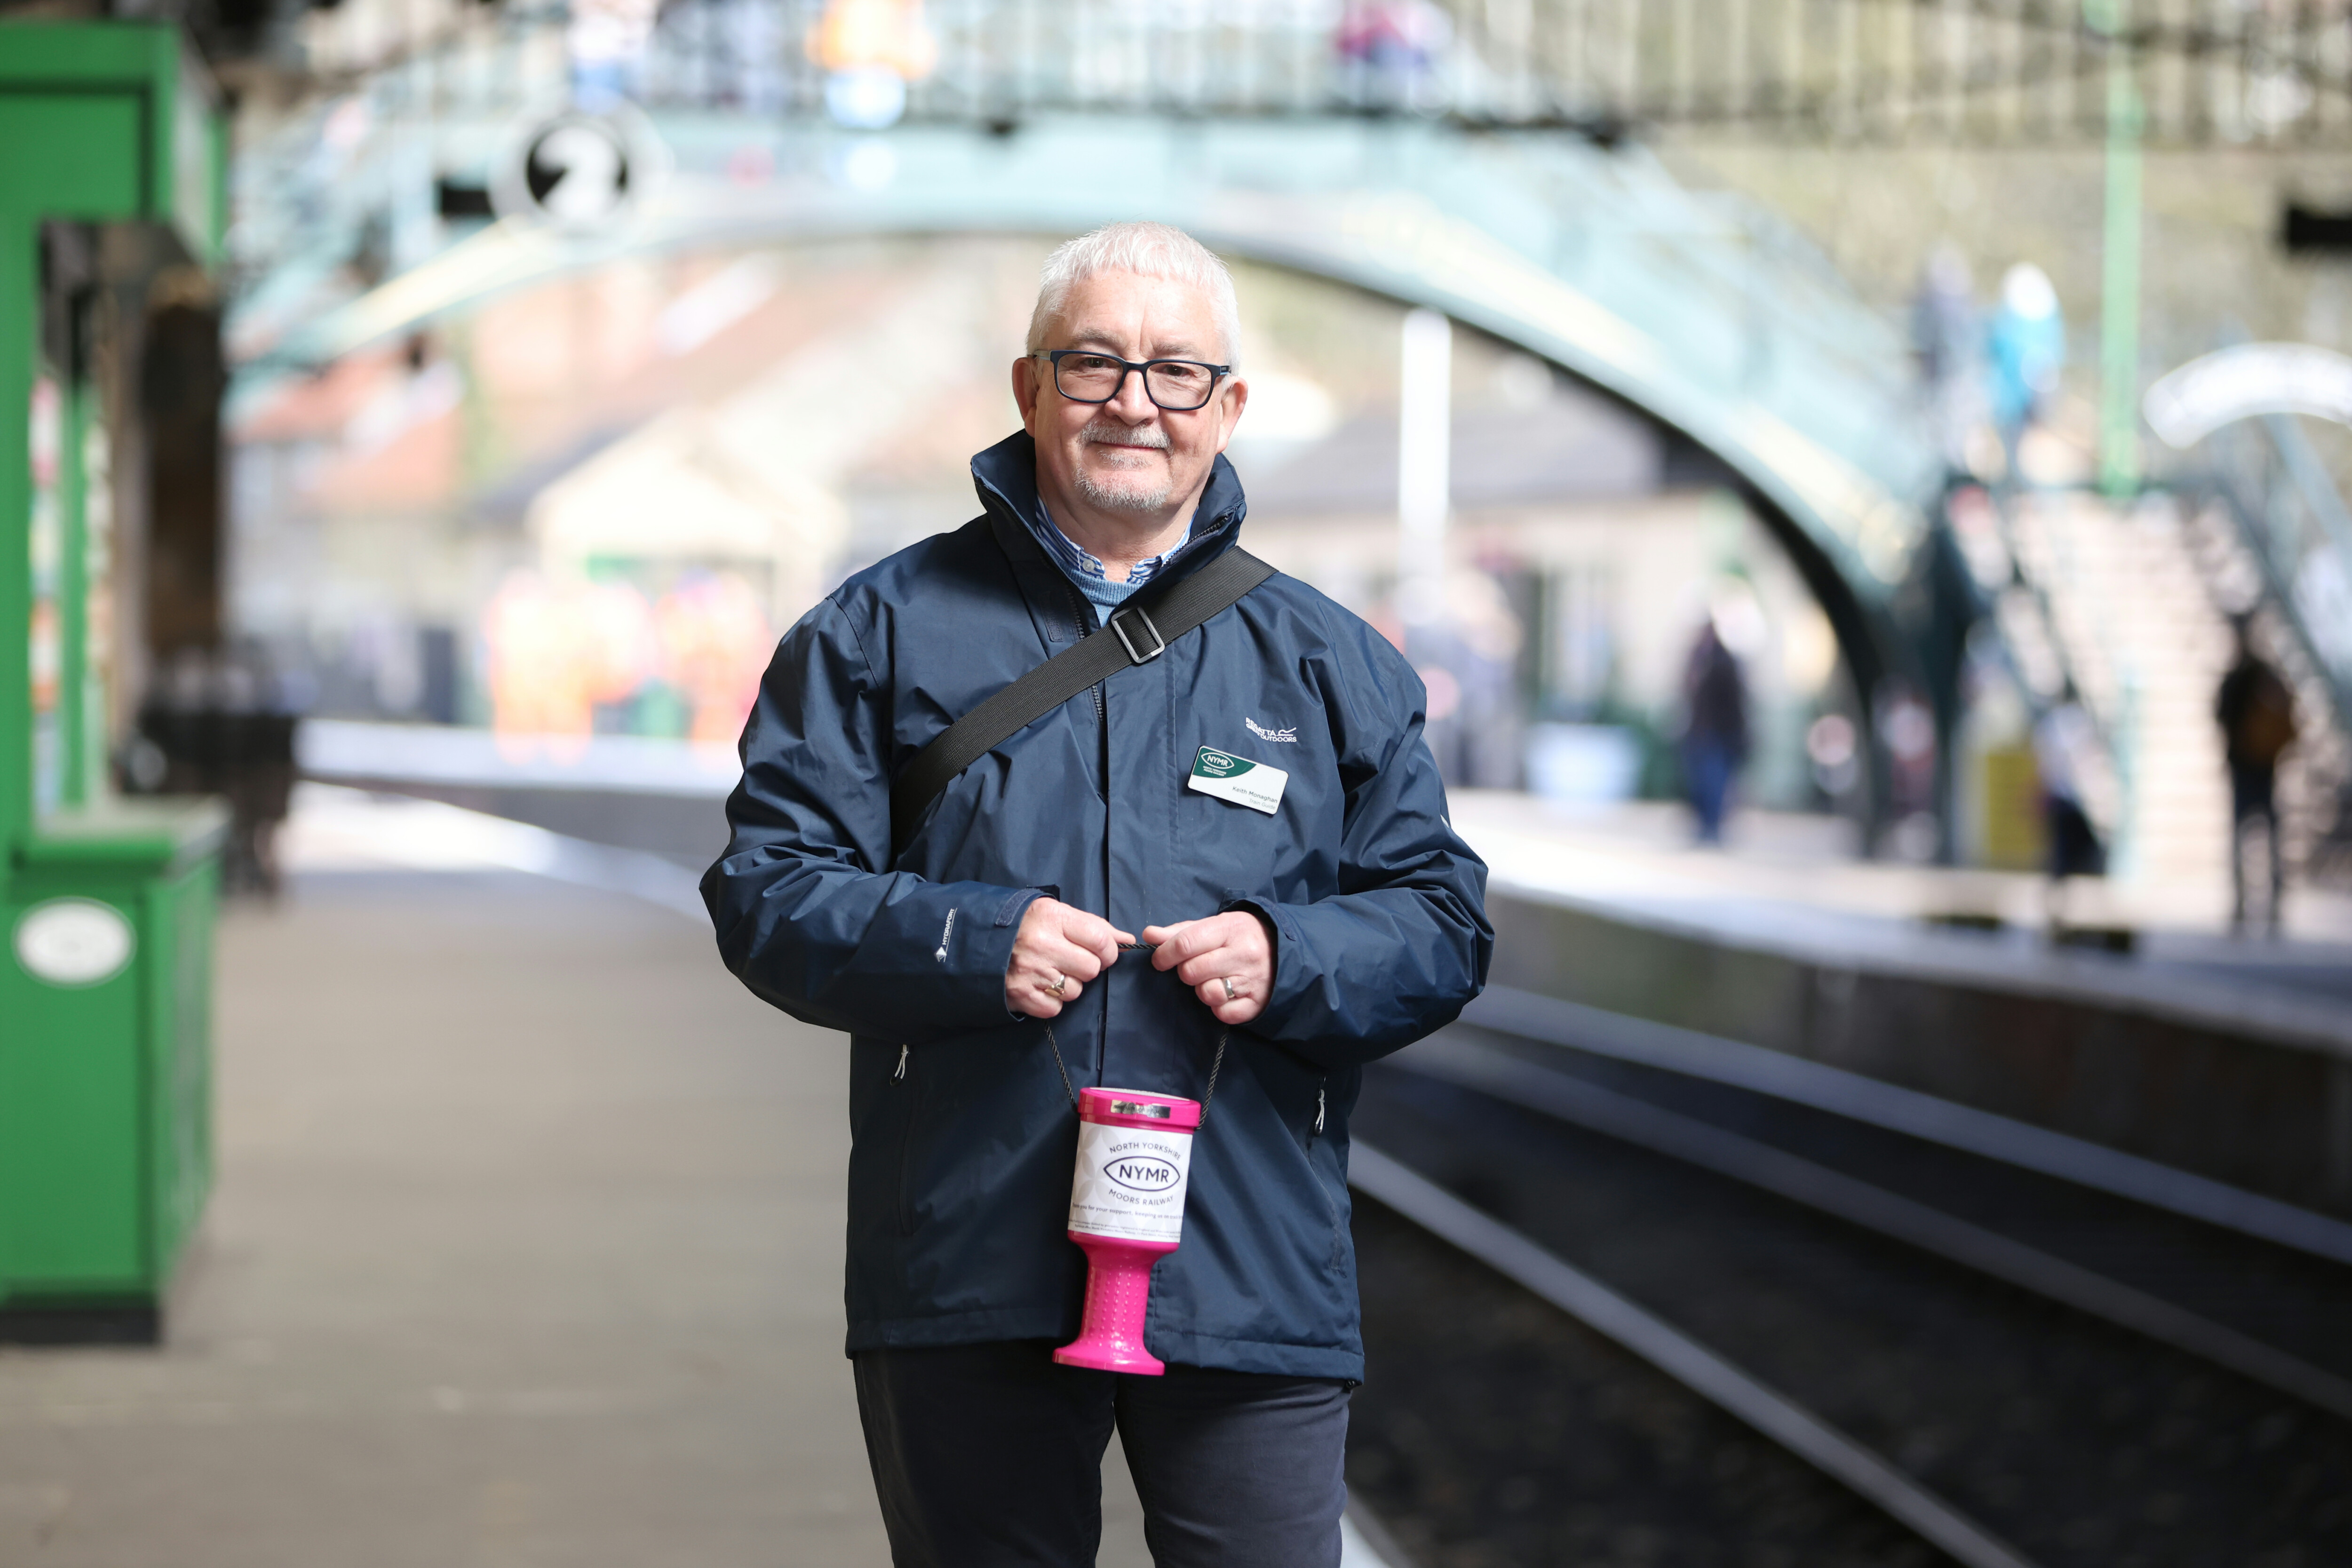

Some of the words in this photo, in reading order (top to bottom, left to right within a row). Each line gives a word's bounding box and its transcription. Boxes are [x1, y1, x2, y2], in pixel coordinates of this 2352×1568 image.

[535, 125, 619, 216] 2
[1207, 755, 1228, 767] NYMR
[1232, 786, 1247, 795] Keith
[1248, 791, 1278, 803] Monaghan
[942, 908, 954, 945] HYDRAFORT
[1109, 1142, 1139, 1154] NORTH
[1142, 1142, 1181, 1161] YORKSHIRE
[1119, 1164, 1169, 1183] NYMR
[1109, 1188, 1140, 1204] MOORS
[1143, 1194, 1173, 1206] RAILWAY
[1135, 1210, 1156, 1219] keeping
